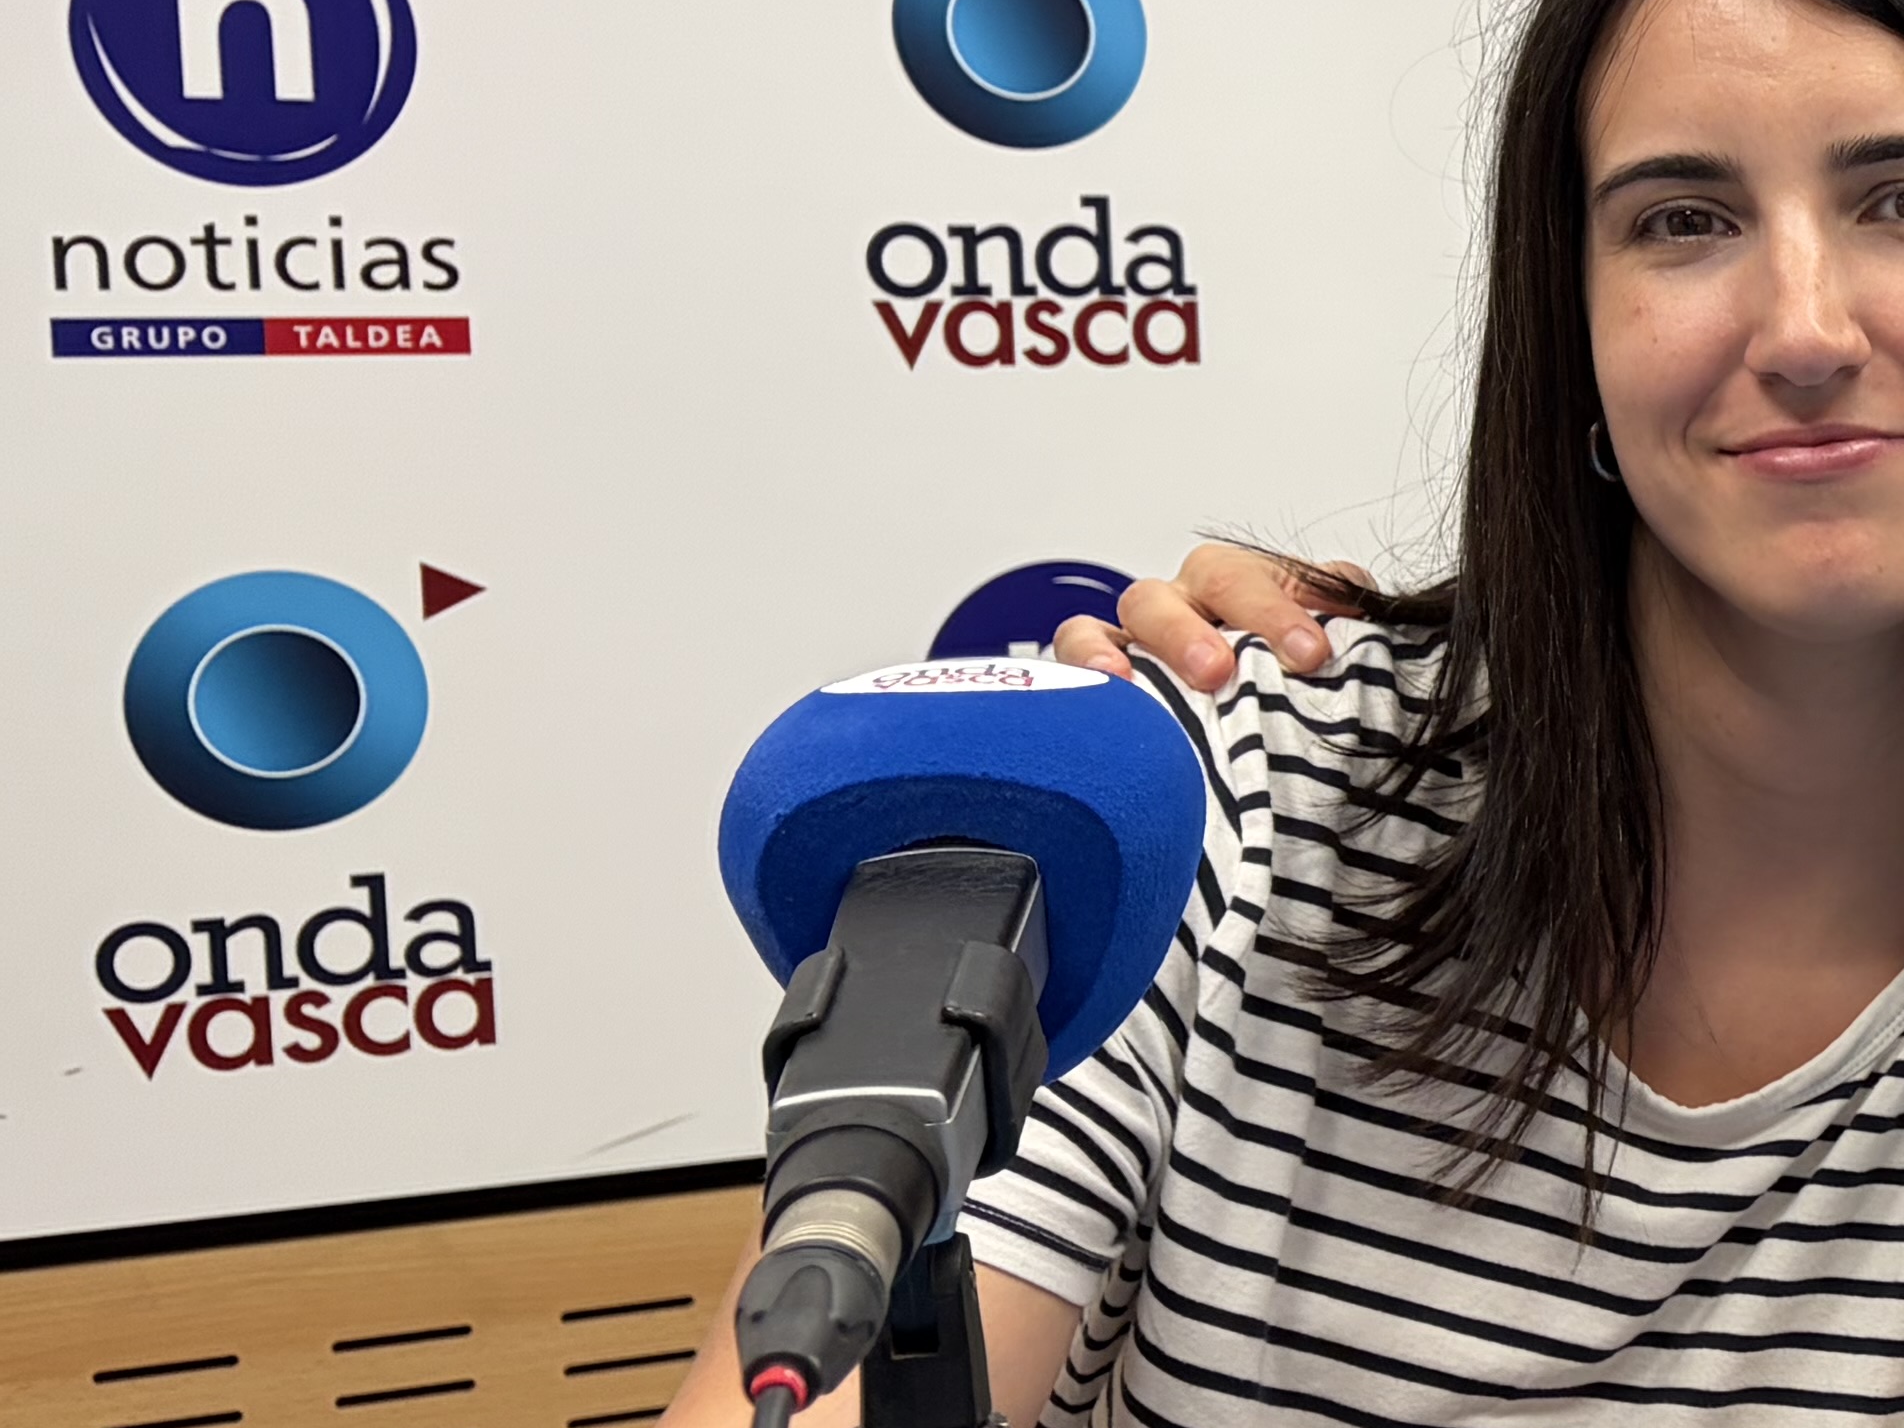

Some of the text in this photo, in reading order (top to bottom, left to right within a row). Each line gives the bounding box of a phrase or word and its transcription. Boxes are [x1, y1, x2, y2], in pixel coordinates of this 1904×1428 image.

[51, 214, 461, 293] noticias
[865, 195, 1198, 298] onda
[89, 323, 444, 351] GRUPO TALDEA
[872, 296, 1202, 371] vasca
[94, 872, 494, 1002] onda
[102, 973, 498, 1081] vasca
